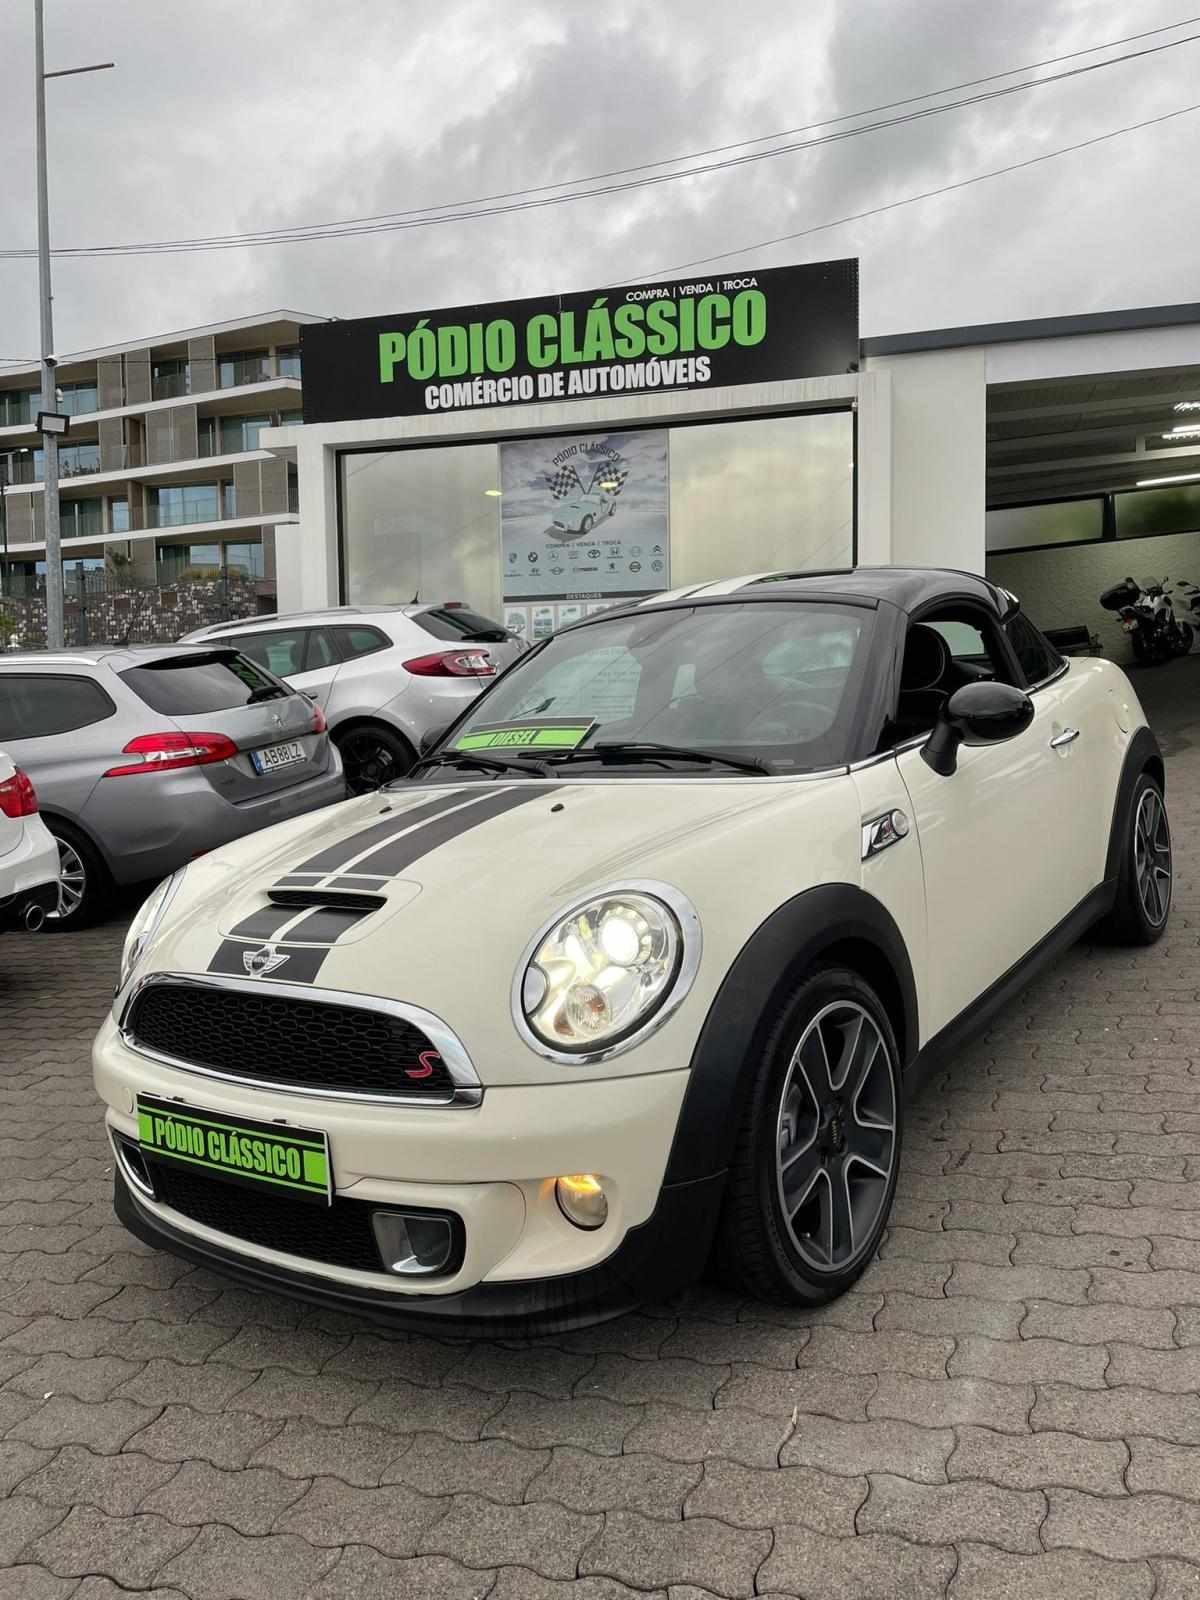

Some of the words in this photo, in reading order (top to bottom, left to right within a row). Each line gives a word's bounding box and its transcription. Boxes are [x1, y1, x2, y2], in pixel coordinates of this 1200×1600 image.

[626, 288, 670, 302] COMPRA
[679, 282, 713, 296] VENDA
[722, 277, 758, 291] TROCA
[379, 319, 516, 384] PÓDIO
[526, 290, 767, 368] CLÁSSICO
[425, 375, 534, 410] COMÉRCIO
[537, 371, 565, 398] DE
[567, 356, 712, 395] AUTOMÓVEIS
[404, 1050, 441, 1079] S
[154, 1116, 205, 1157] PÓDIO
[208, 1130, 302, 1180] CLÁSSICO
